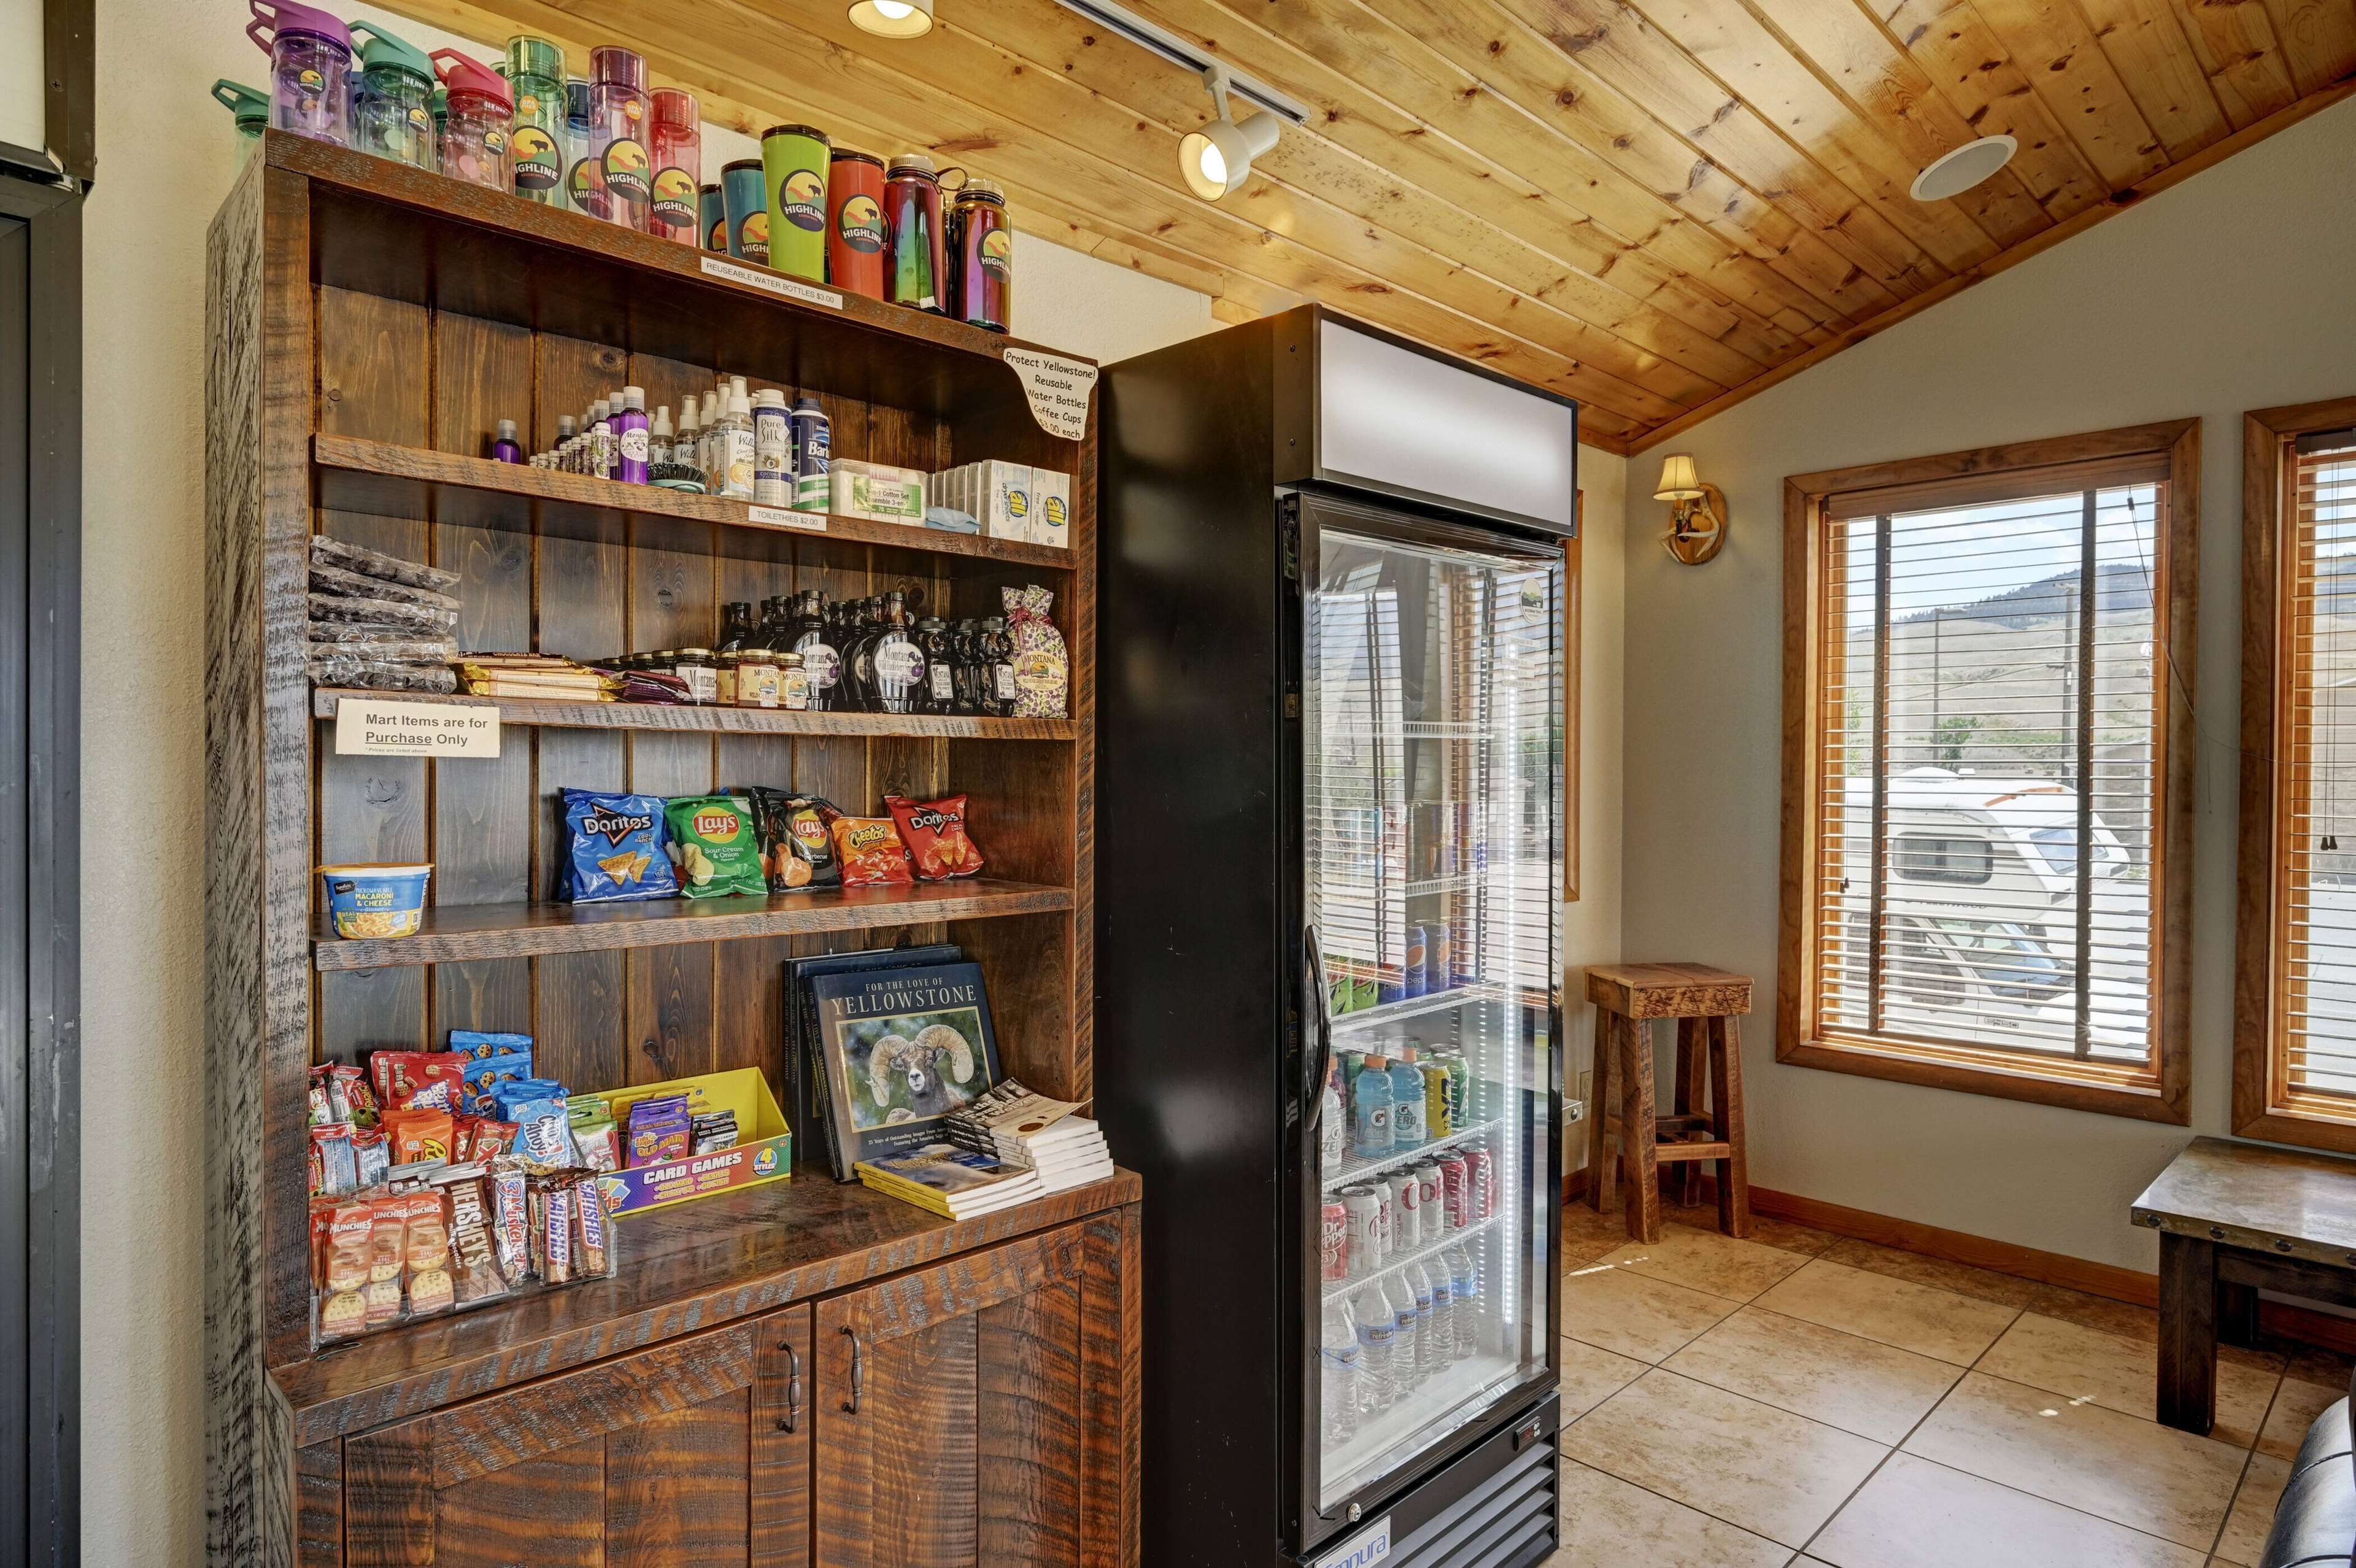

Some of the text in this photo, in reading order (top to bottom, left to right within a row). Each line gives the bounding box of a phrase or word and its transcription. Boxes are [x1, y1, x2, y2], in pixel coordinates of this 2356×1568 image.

[299, 82, 323, 91] HIGHLINE
[514, 163, 558, 180] IGHLINE
[653, 201, 698, 220] HIGHLINE
[784, 204, 825, 225] HIGHLINE
[843, 228, 883, 246] HIGHLINE
[706, 262, 835, 304] REUSEABLE WATER BOTTLES $3.00
[1005, 351, 1096, 379] Protect Yellowstone!
[1035, 374, 1073, 391] Reusable
[1026, 387, 1087, 409] Water Bottles
[1033, 404, 1082, 426] Coffee Cups
[761, 419, 781, 429] Pure
[762, 427, 782, 444] Silk
[1062, 428, 1081, 439] each
[1009, 490, 1027, 517] all
[1046, 496, 1065, 526] all
[800, 517, 819, 526] $2.00
[1024, 654, 1056, 665] MONTANA
[689, 670, 716, 688] Montana
[365, 713, 489, 728] Mart Items are for
[365, 731, 468, 747] Purchase Only
[584, 814, 652, 835] Doritos
[698, 814, 736, 836] Lay's
[795, 819, 825, 839] Lay's
[910, 812, 960, 830] Doritos
[849, 824, 886, 849] Cheetos
[865, 976, 943, 992] FOR THE LOVE OF
[1383, 981, 1405, 991] peps
[1407, 976, 1426, 986] peps
[830, 984, 976, 1016] YELLOWSTONE
[964, 1099, 1016, 1118] Temple
[973, 1099, 997, 1110] the
[988, 1095, 1040, 1116] Wolves
[637, 1134, 685, 1157] OLD MAID
[890, 1133, 913, 1141] Outstanding
[1323, 1141, 1341, 1153] ZER
[760, 1148, 773, 1164] 4
[643, 1151, 743, 1185] CARD GAMES
[701, 1168, 730, 1182] HEARTS
[501, 1180, 521, 1195] 3
[659, 1181, 676, 1192] OLD
[373, 1208, 409, 1219] UNCHIES
[407, 1202, 442, 1217] UNCHIES
[579, 1182, 602, 1247] SATISFIES
[1397, 1212, 1402, 1224] ME
[330, 1218, 373, 1234] MUNCHIES
[450, 1181, 492, 1268] HERSHEY'S
[1324, 1222, 1340, 1235] Dr
[1322, 1225, 1346, 1246] epper
[1401, 1315, 1416, 1325] refre
[1343, 1353, 1358, 1362] refre
[1326, 1534, 1387, 1568] mpura
